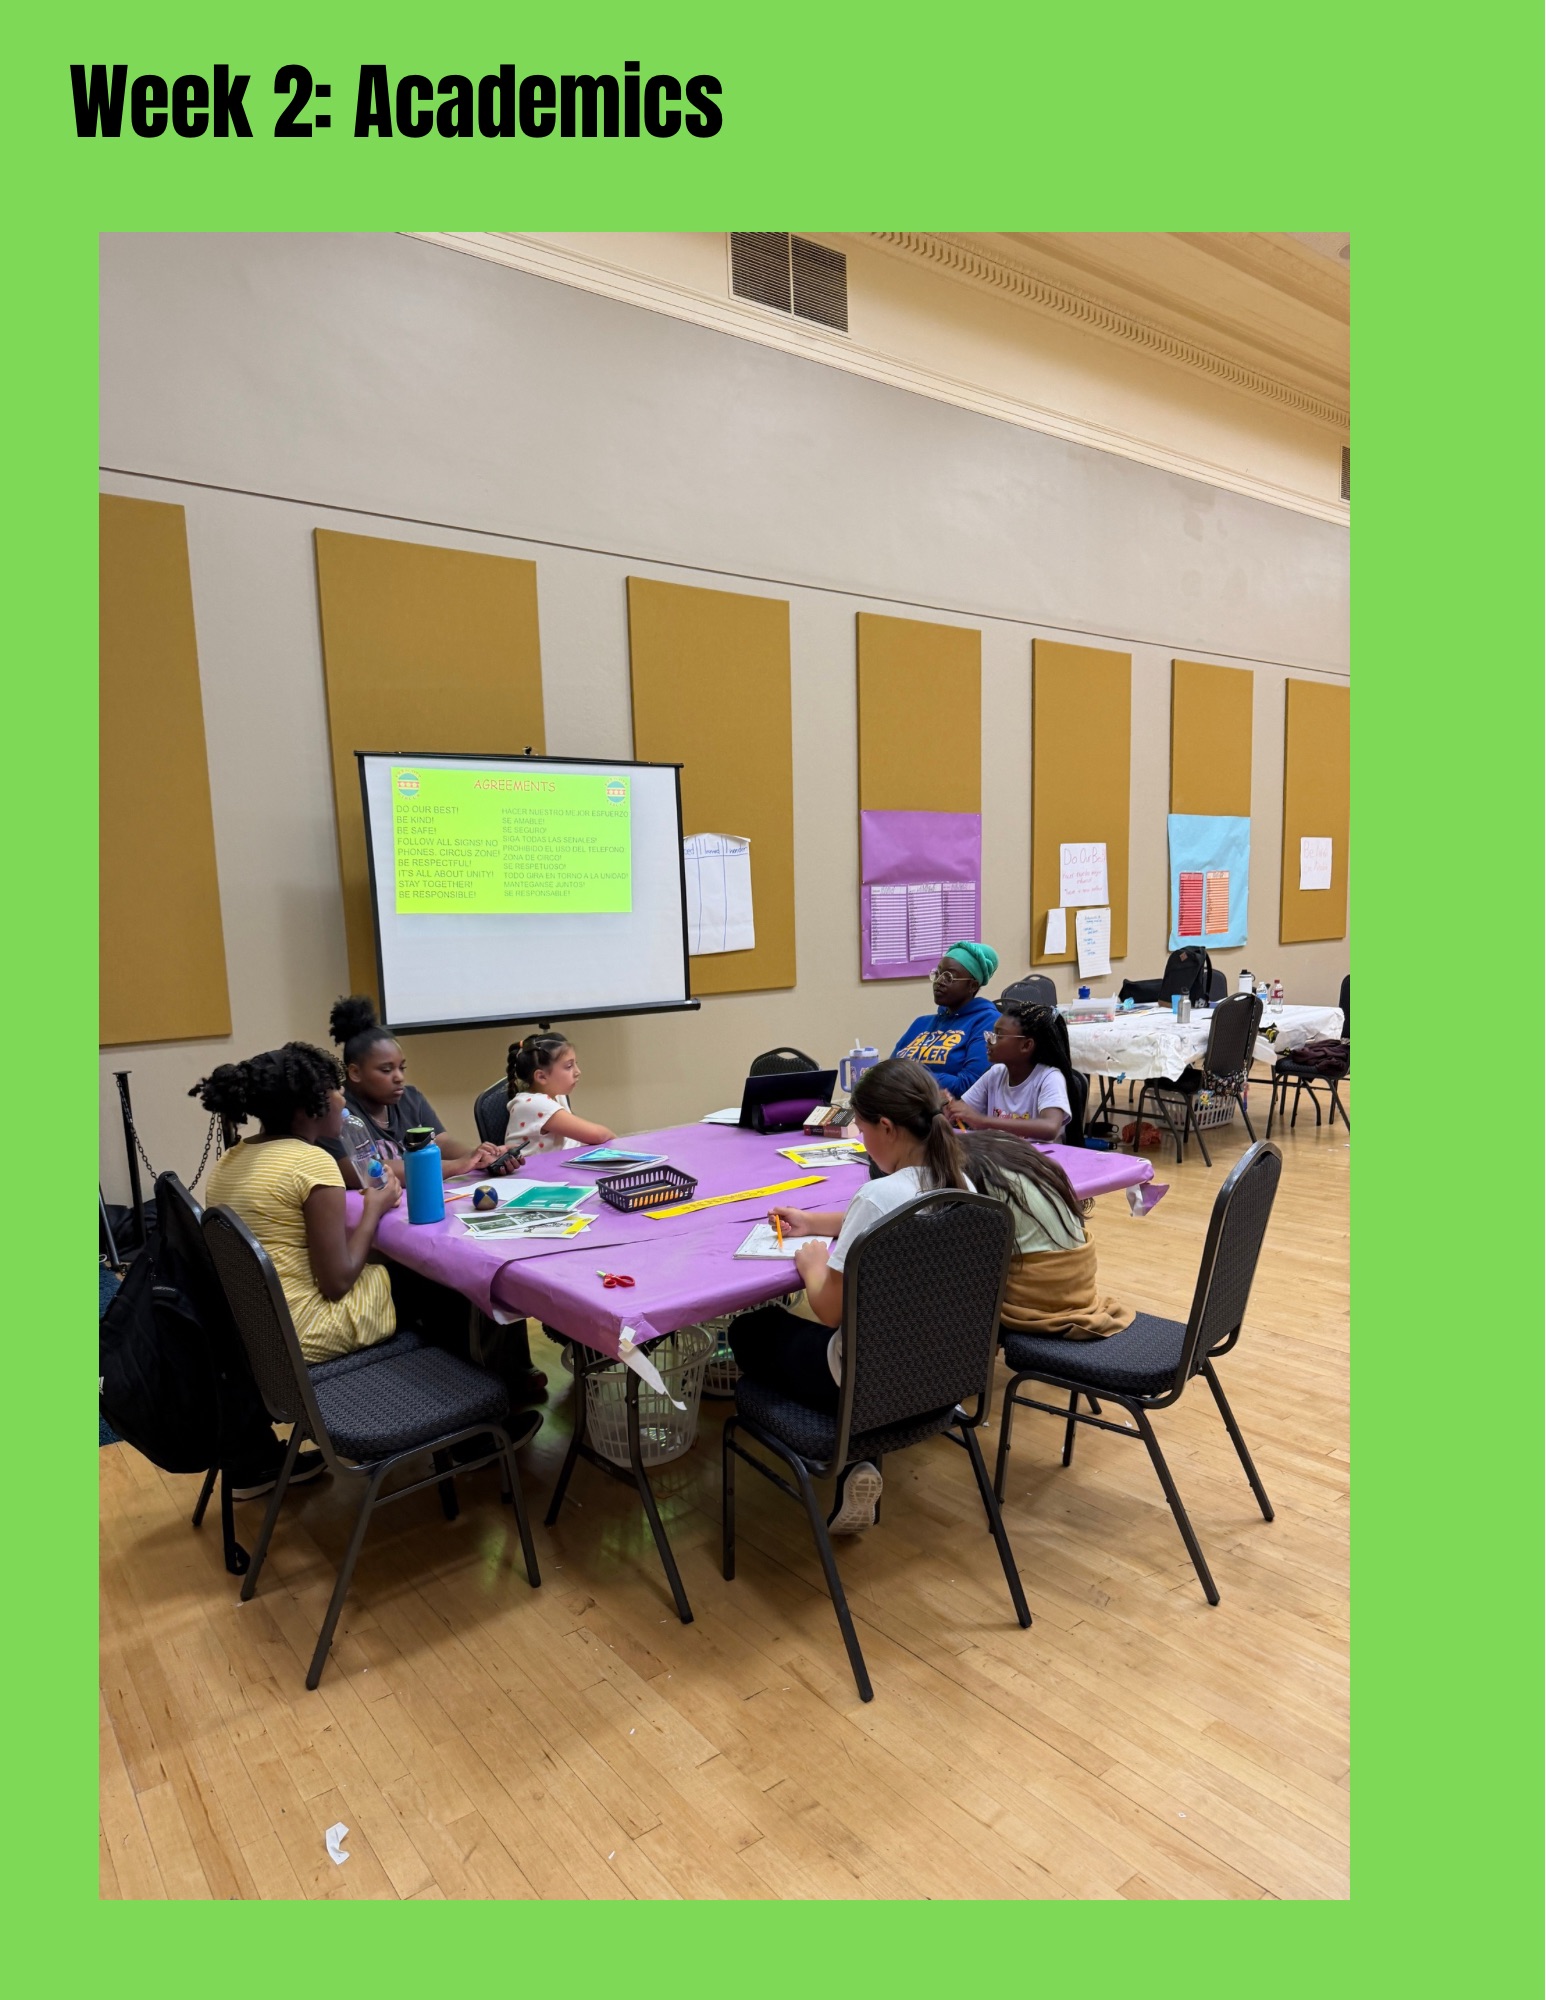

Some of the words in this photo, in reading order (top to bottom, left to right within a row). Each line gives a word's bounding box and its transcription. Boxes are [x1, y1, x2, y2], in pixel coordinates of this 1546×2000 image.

[473, 779, 556, 792] AGREEMENTS
[396, 805, 410, 813] DO
[411, 805, 431, 813] OUR
[433, 806, 459, 814] BEST!
[410, 816, 434, 824] KIND!
[397, 827, 409, 835] BE
[411, 827, 437, 835] SAFE!
[397, 838, 434, 846] FOLLOW
[436, 838, 452, 846] ALL
[454, 838, 483, 846] SIGNS!
[485, 839, 498, 847] NO
[397, 848, 437, 856] PHONES.
[439, 849, 472, 857] CIRCUS
[474, 849, 500, 857] ZONE!
[398, 859, 410, 867] BE
[412, 859, 472, 867] RESPECTFUL!
[466, 870, 494, 878] UNITY!
[398, 880, 420, 888] STAY
[422, 880, 473, 888] TOGETHER!
[412, 891, 476, 899] RESPONSIBLE!
